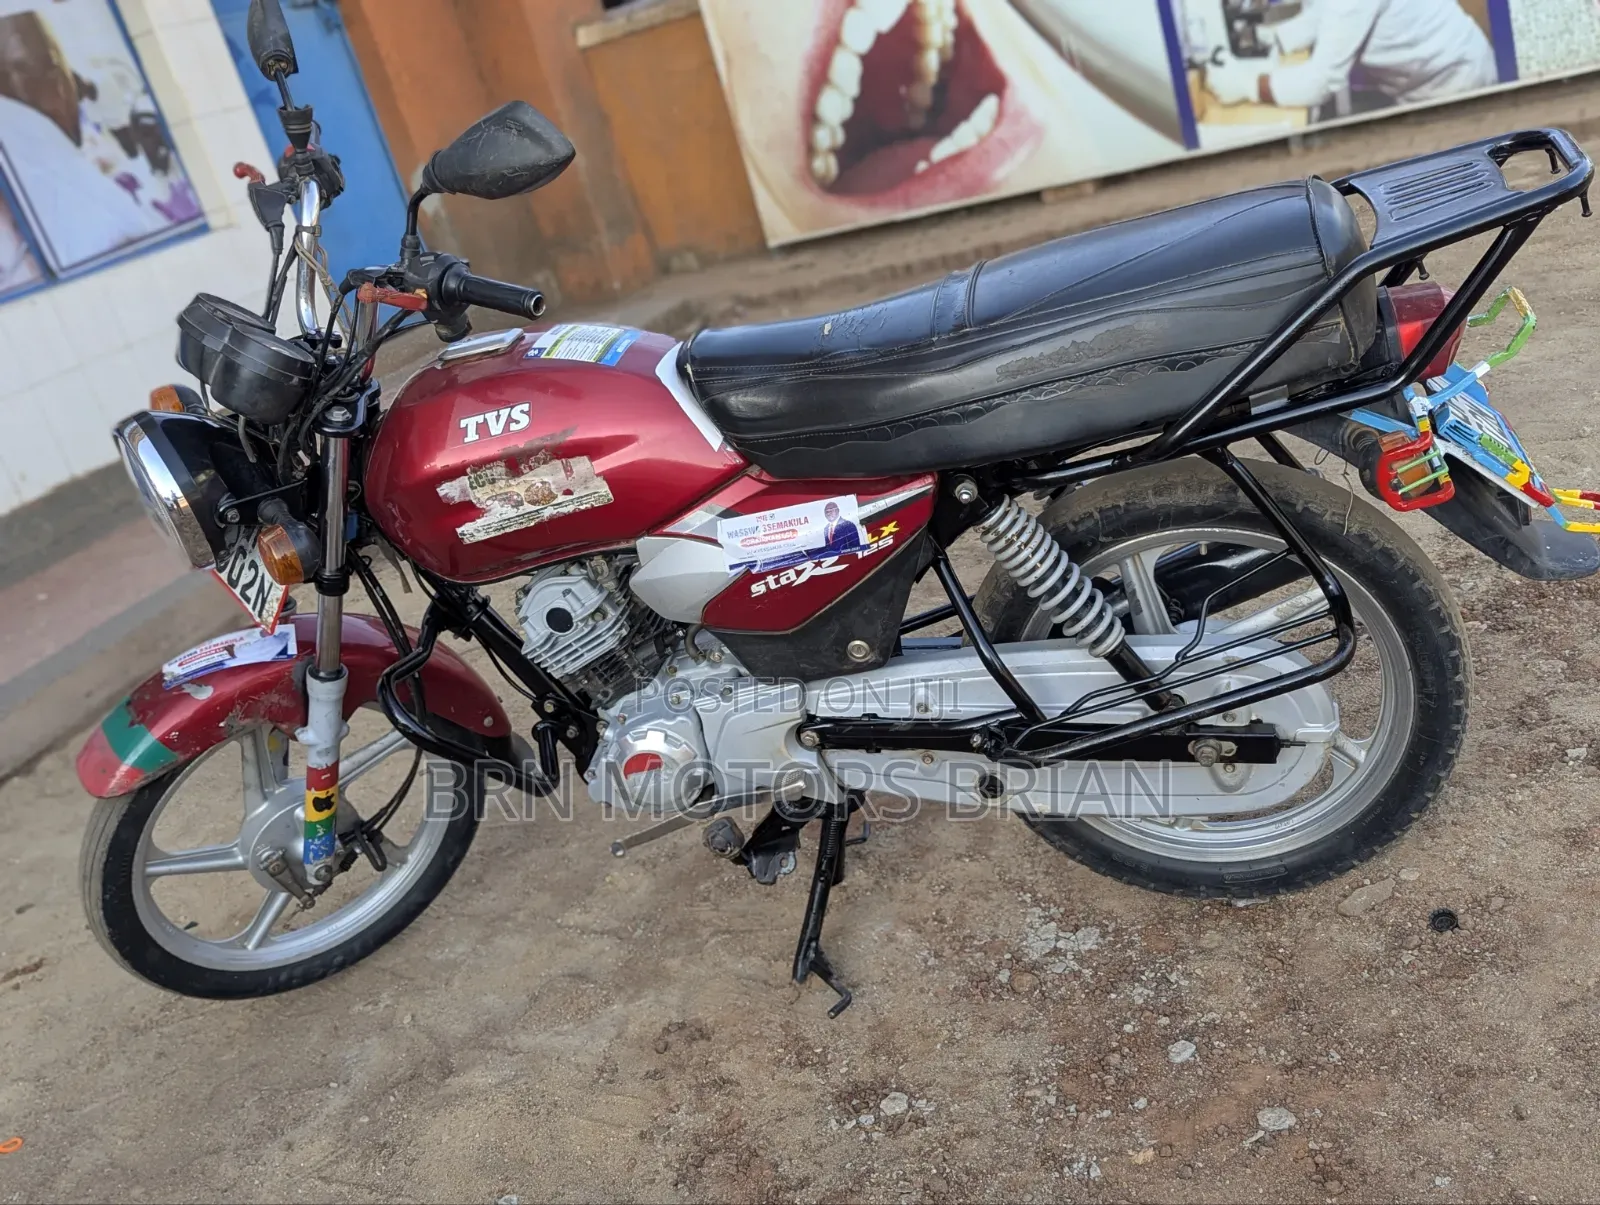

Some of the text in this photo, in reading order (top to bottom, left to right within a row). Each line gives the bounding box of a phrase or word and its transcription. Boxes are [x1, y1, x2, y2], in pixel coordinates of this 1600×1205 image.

[459, 402, 531, 443] TVS
[867, 520, 900, 543] LX
[855, 535, 894, 559] 125
